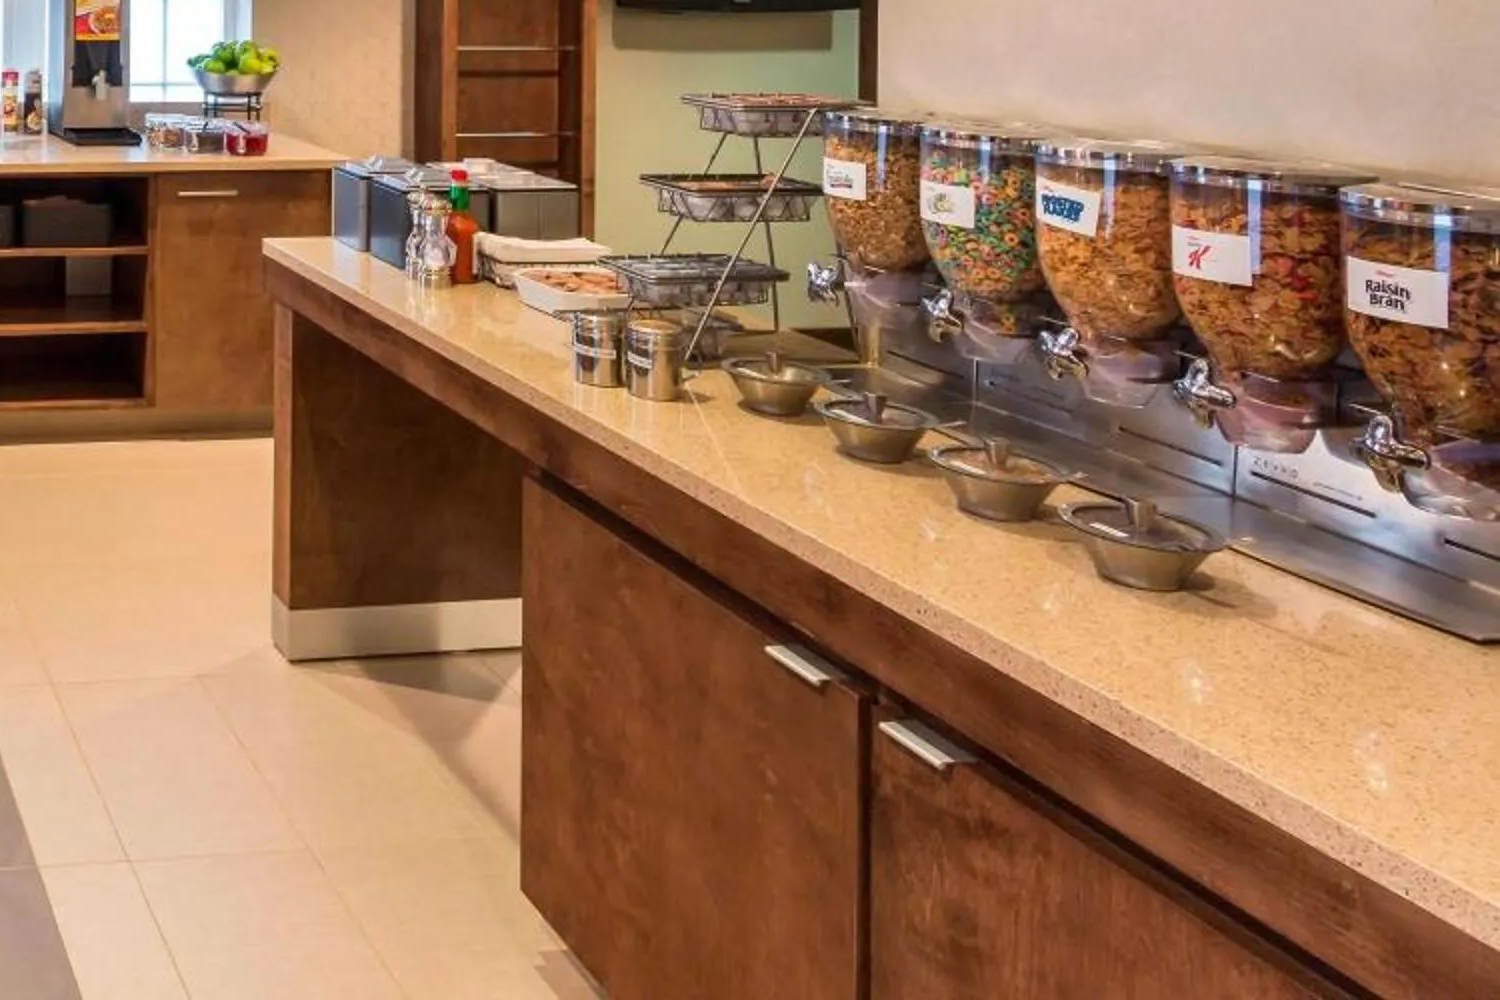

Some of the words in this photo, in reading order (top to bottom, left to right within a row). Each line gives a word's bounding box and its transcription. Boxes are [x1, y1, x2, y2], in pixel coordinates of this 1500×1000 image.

[1188, 245, 1211, 269] K
[1365, 279, 1410, 300] Raisin
[1369, 294, 1405, 311] Bran
